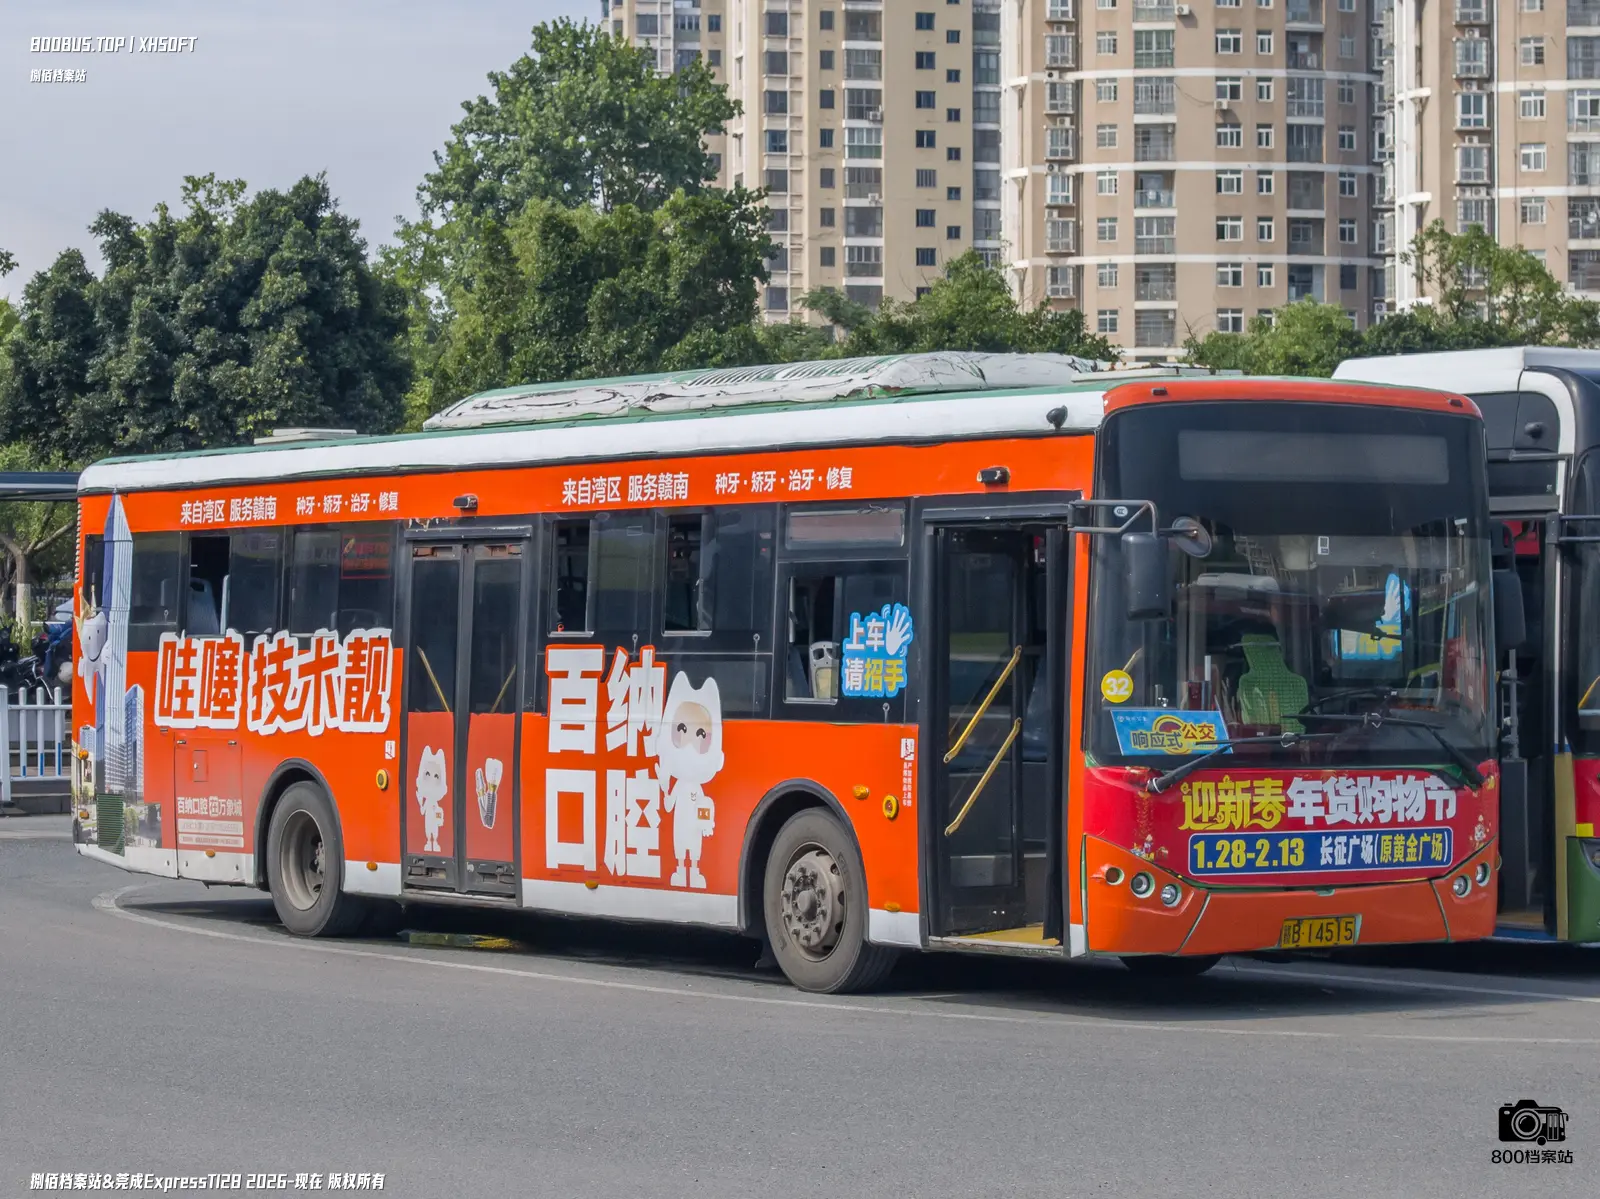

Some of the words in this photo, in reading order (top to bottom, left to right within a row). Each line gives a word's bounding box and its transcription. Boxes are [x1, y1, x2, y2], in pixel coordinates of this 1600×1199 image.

[562, 476, 622, 506] 来自湾区
[628, 471, 689, 503] 服务赣南
[180, 499, 225, 525] 来自湾区
[229, 495, 277, 521] 服务赣南
[845, 617, 885, 652] 上车
[844, 657, 905, 692] 请招手
[1106, 677, 1130, 696] 32
[546, 646, 667, 758] 百纳
[545, 768, 662, 879] 口腔
[1193, 838, 1305, 869] 1.28-2.13
